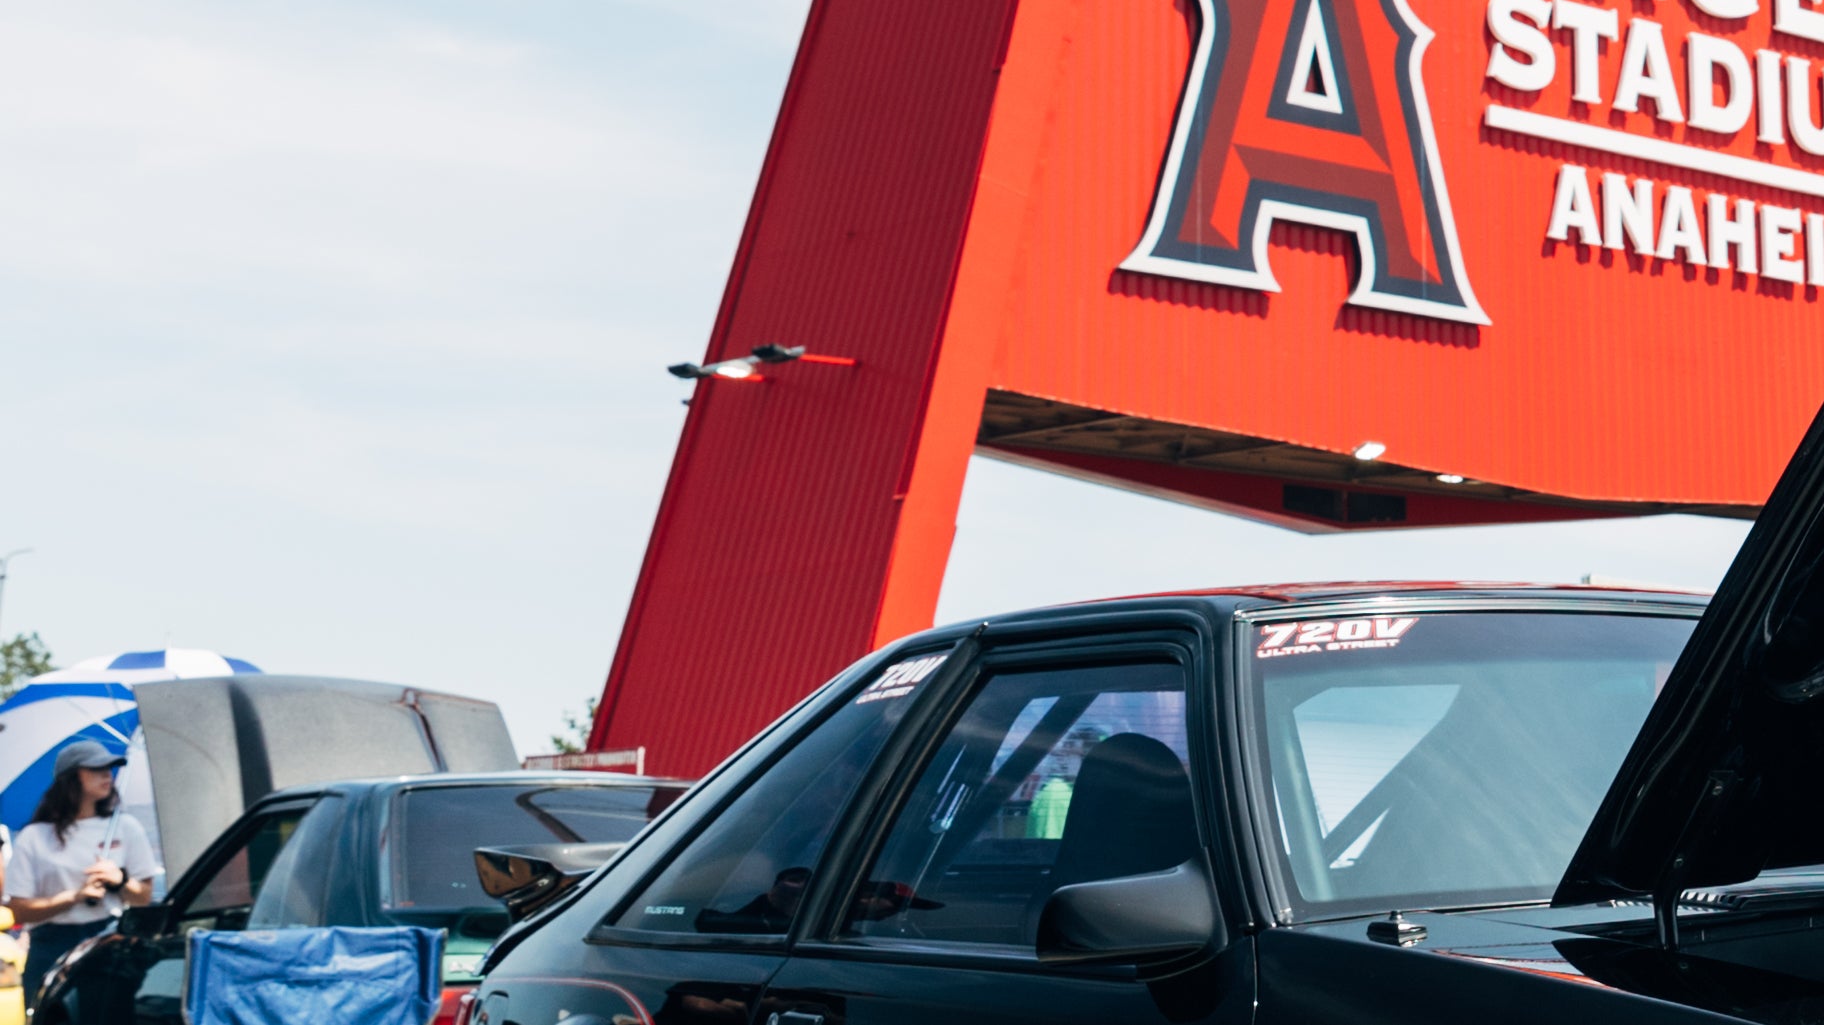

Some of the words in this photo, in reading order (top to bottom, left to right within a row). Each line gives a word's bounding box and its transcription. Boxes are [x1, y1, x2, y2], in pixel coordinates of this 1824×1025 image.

[1257, 616, 1419, 650] 720V
[1256, 644, 1323, 658] ULTRA
[1325, 638, 1400, 651] STREET
